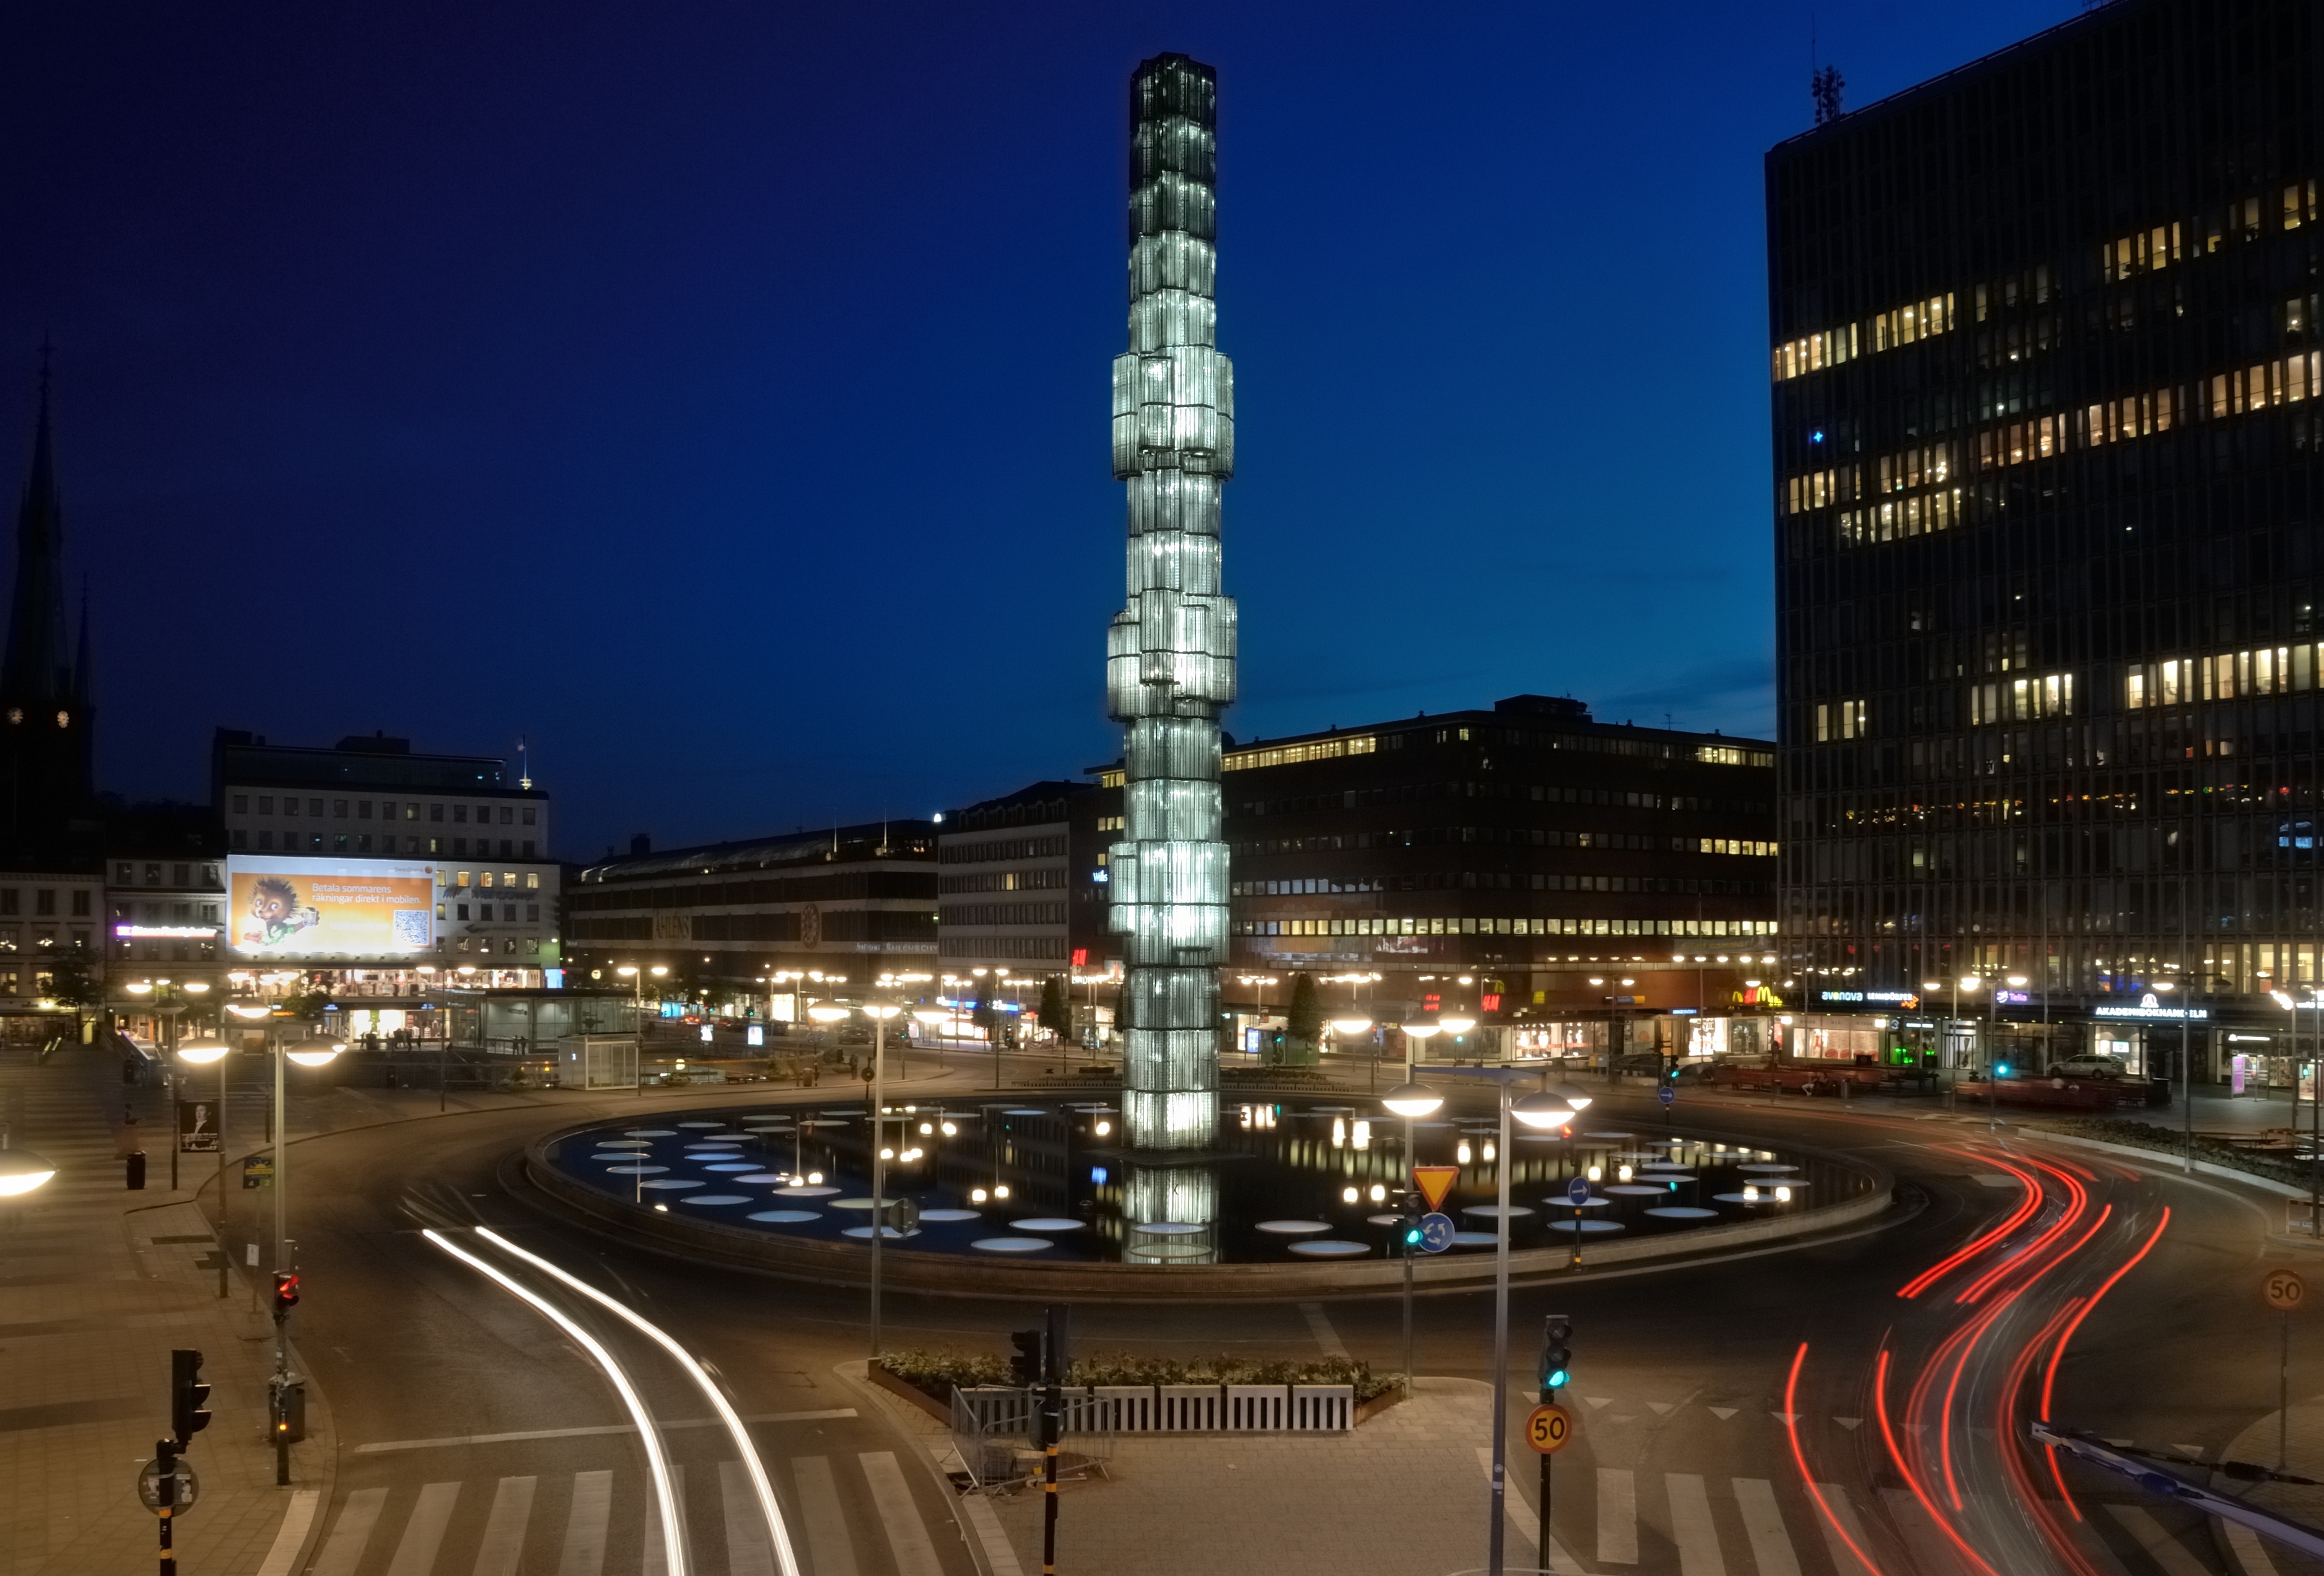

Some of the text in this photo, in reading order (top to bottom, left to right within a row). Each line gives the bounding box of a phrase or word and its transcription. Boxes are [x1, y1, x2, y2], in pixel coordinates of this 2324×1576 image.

[312, 883, 391, 893] Betala sommarens
[312, 894, 353, 904] räkningar
[355, 895, 380, 903] direkt
[386, 896, 422, 904] mobilen.
[1822, 991, 1863, 1001] avonova
[2009, 993, 2027, 1001] Telia
[2271, 1280, 2300, 1301] 50
[1534, 1417, 1565, 1441] 50
